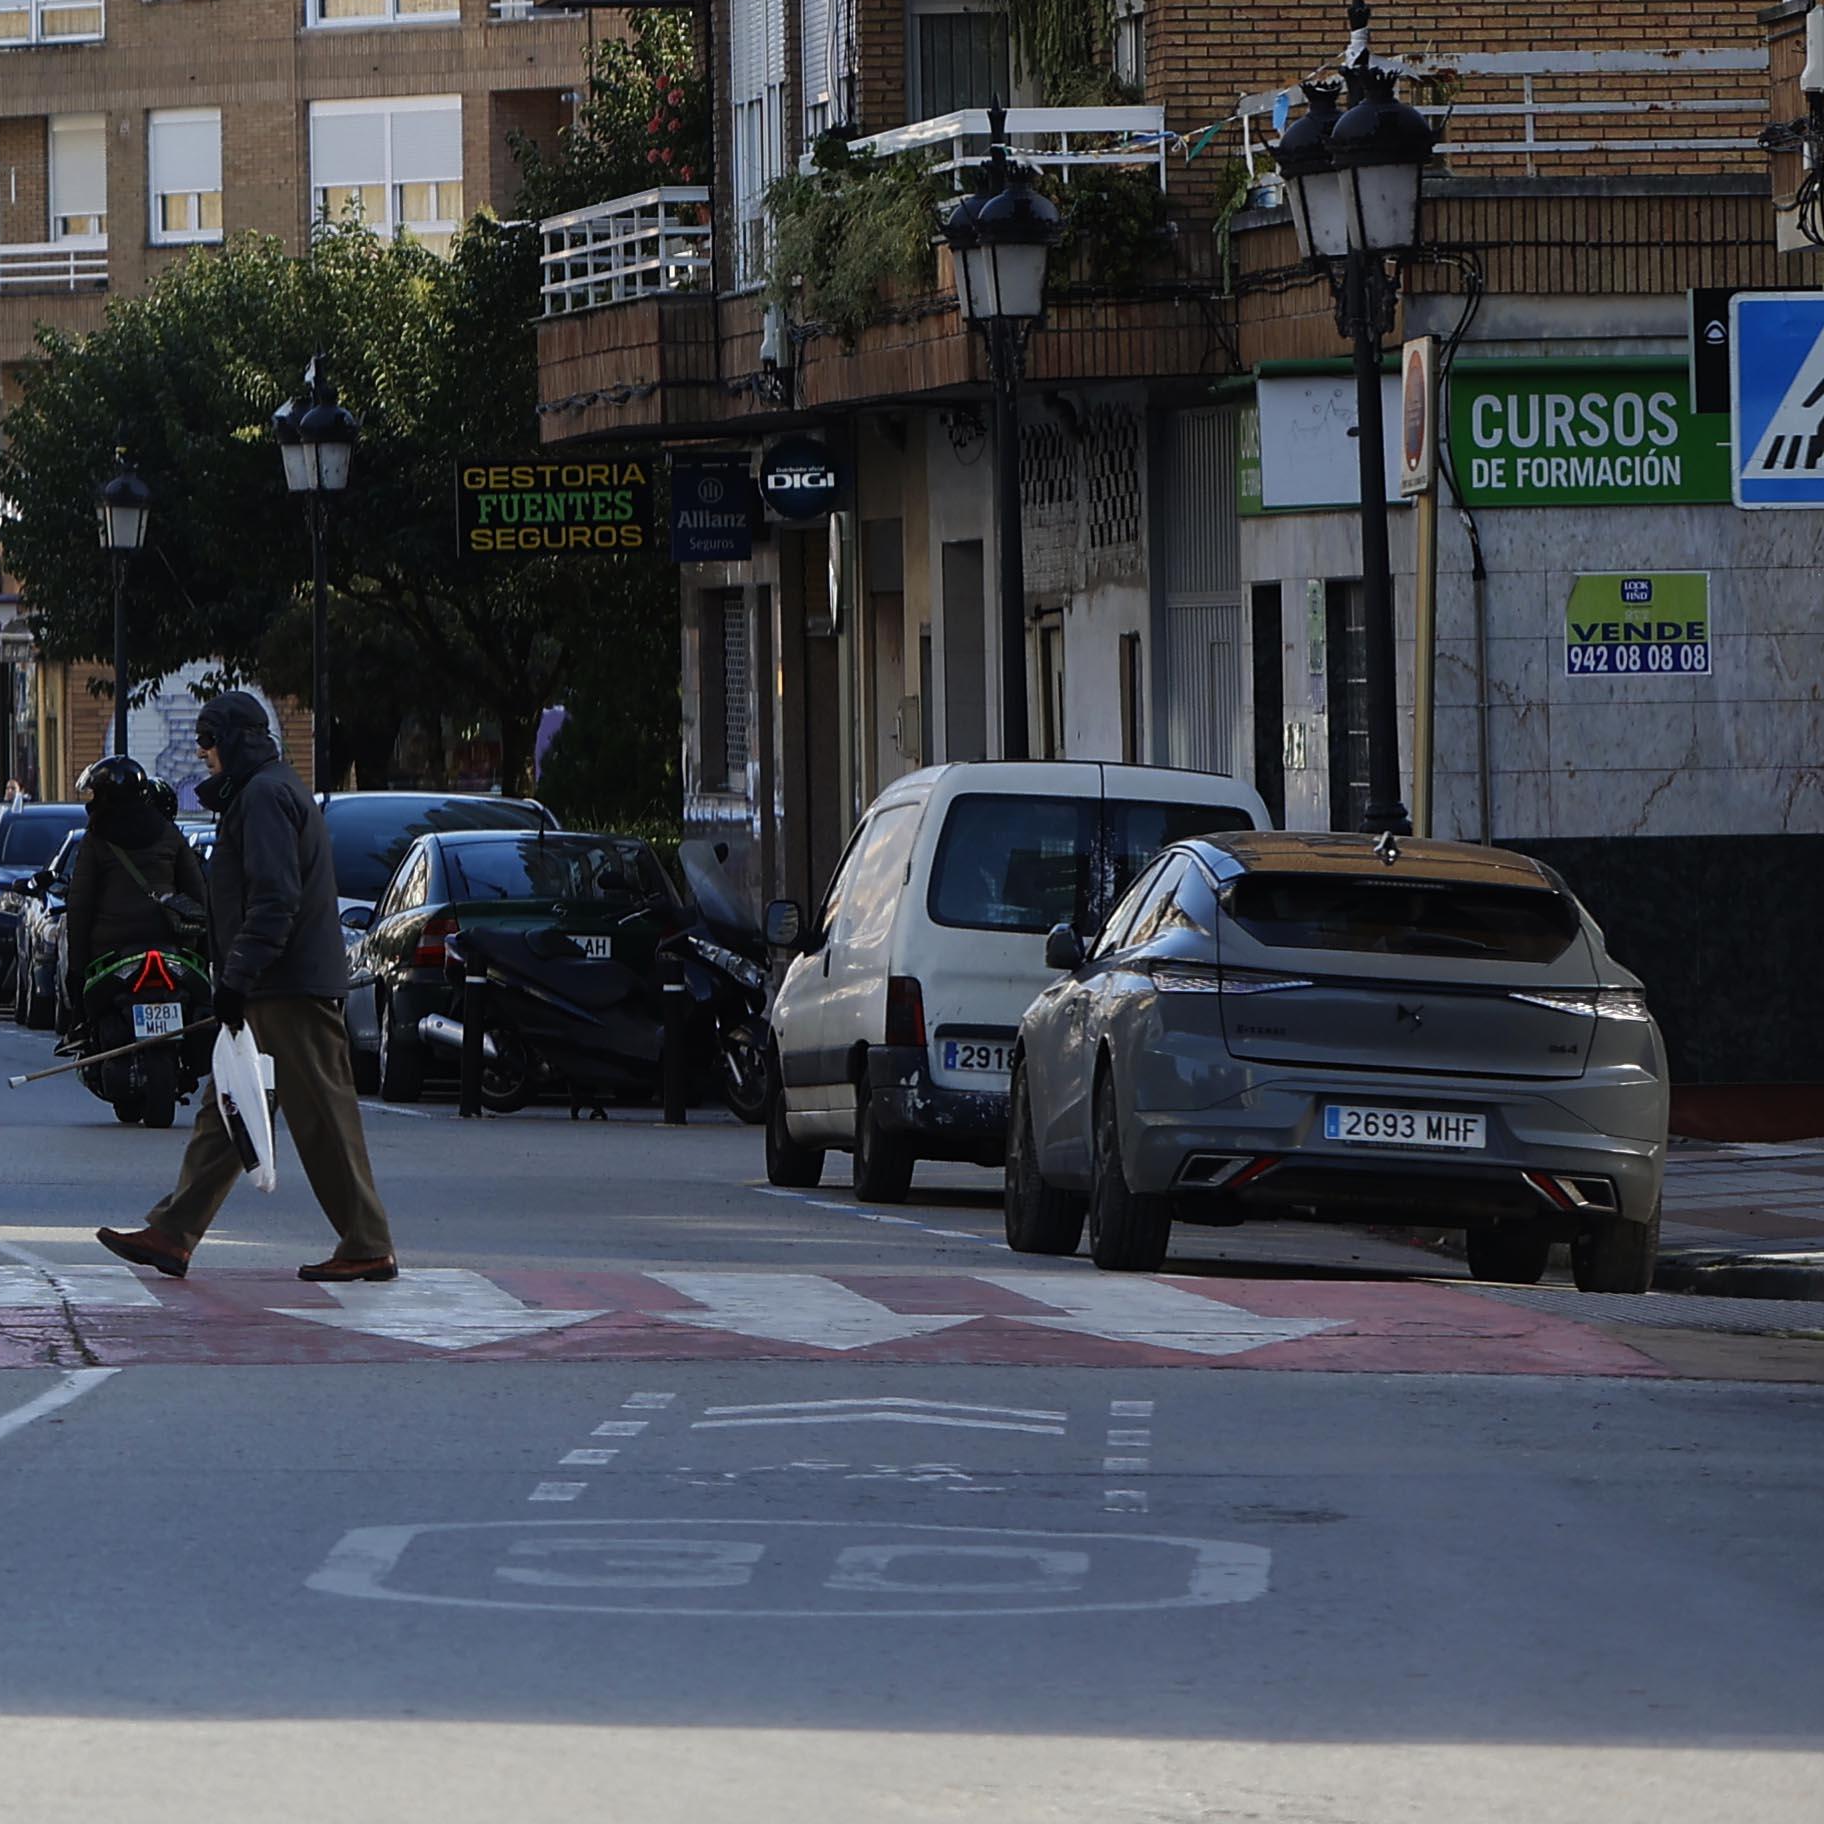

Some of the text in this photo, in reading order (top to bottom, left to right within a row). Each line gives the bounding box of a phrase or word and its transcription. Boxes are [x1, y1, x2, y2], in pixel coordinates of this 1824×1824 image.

[1472, 392, 1678, 448] CURSOS
[463, 463, 646, 489] GESTORIA
[767, 472, 835, 489] DIGI
[1472, 448, 1680, 488] DE FORMACIÓN
[478, 490, 634, 524] FUENTES
[677, 509, 747, 528] Allianz
[470, 525, 643, 550] SEGUROS
[689, 537, 734, 552] Seguros
[1624, 581, 1648, 590] LOOK
[1626, 591, 1648, 600] FIND
[1571, 622, 1705, 641] VENDE
[1570, 644, 1706, 672] 942 08 08 08
[144, 1005, 179, 1020] 9281
[1346, 1111, 1479, 1143] 2693 MHF
[495, 1536, 1089, 1594] 30
